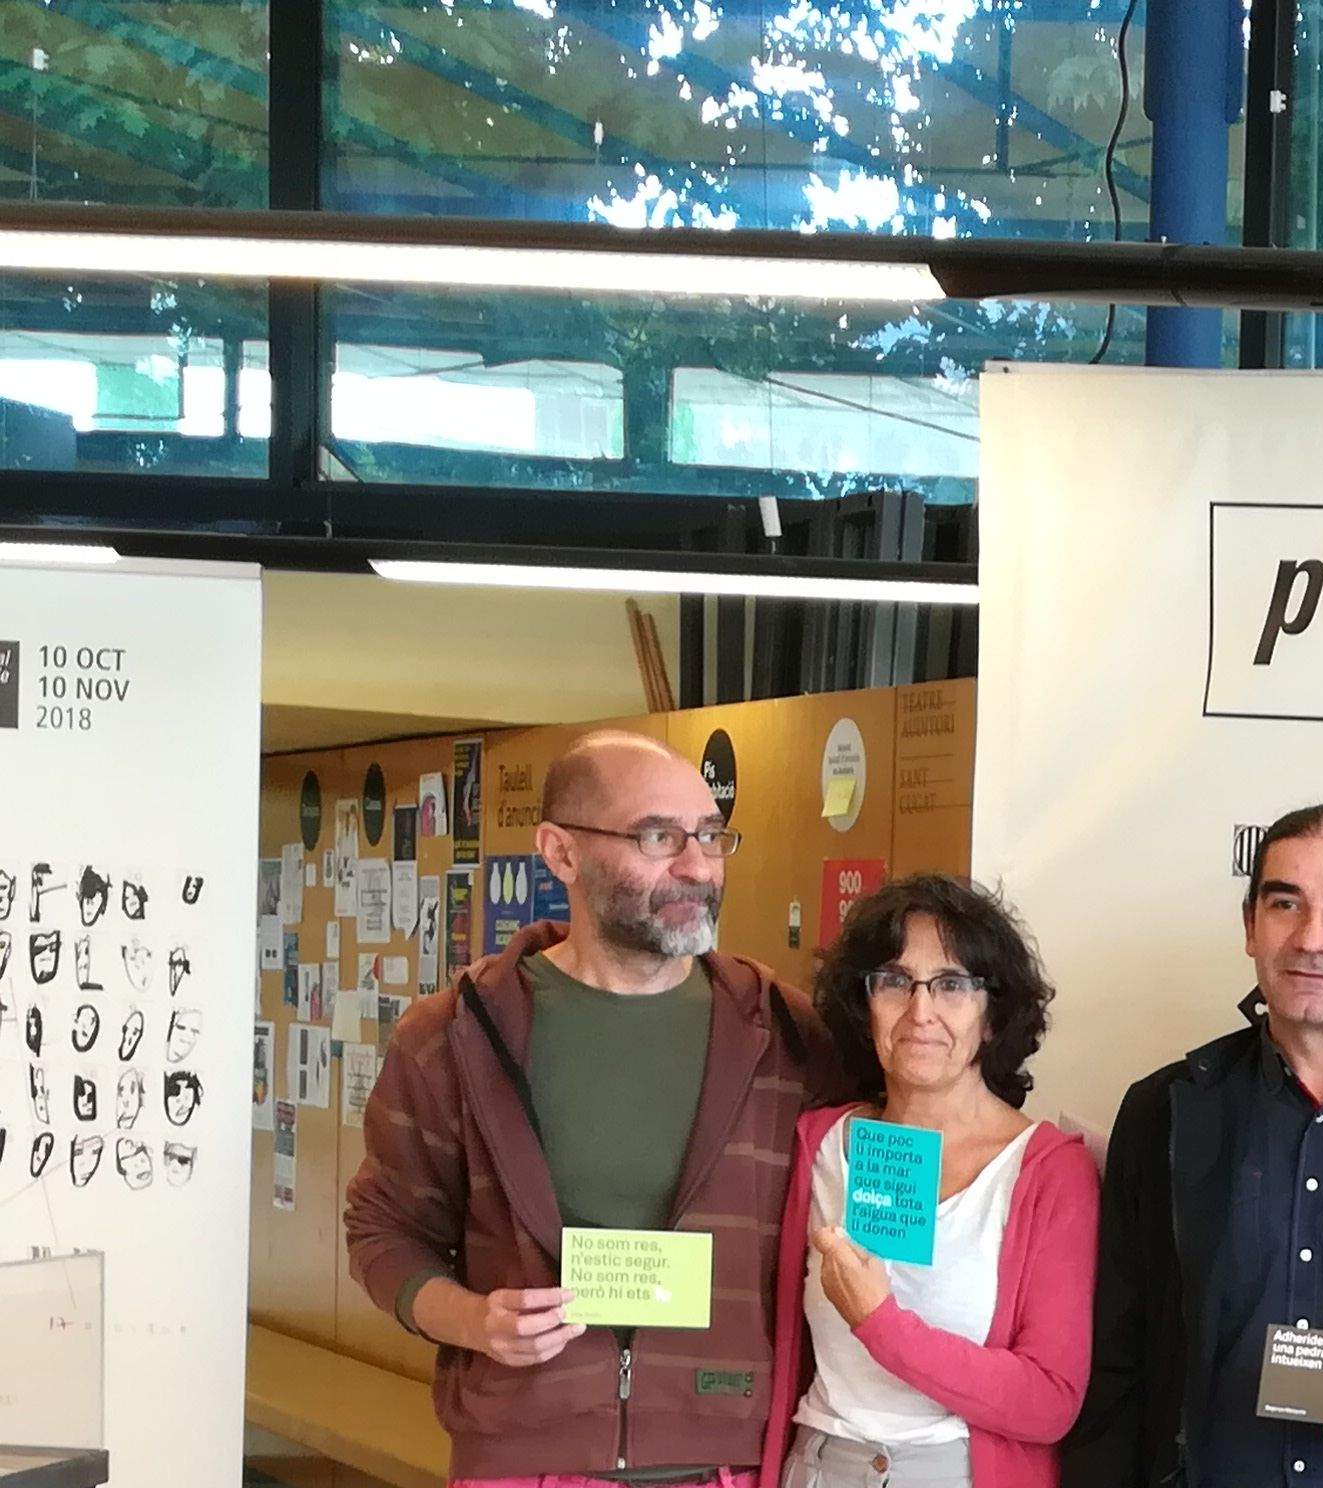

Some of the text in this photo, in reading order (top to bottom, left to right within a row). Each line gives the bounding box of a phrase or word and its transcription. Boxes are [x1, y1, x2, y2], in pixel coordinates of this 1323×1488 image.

[39, 645, 67, 668] 10
[76, 647, 126, 671] OCT
[39, 676, 130, 702] 10 NOV
[36, 705, 91, 730] 2018
[839, 870, 861, 894] 900
[857, 1127, 913, 1147] Que poc
[868, 1145, 923, 1165] importa
[855, 1160, 912, 1178] a la mar
[854, 1175, 916, 1197] que sigui
[852, 1188, 923, 1211] dolça tota
[852, 1205, 926, 1227] l'aigua que
[862, 1221, 906, 1239] donen
[572, 1235, 662, 1253] No som res,
[571, 1252, 671, 1271] n'estic segur.
[571, 1268, 662, 1285] No som res,
[609, 1285, 623, 1299] hi
[627, 1288, 651, 1300] ets
[1273, 1343, 1294, 1354] una
